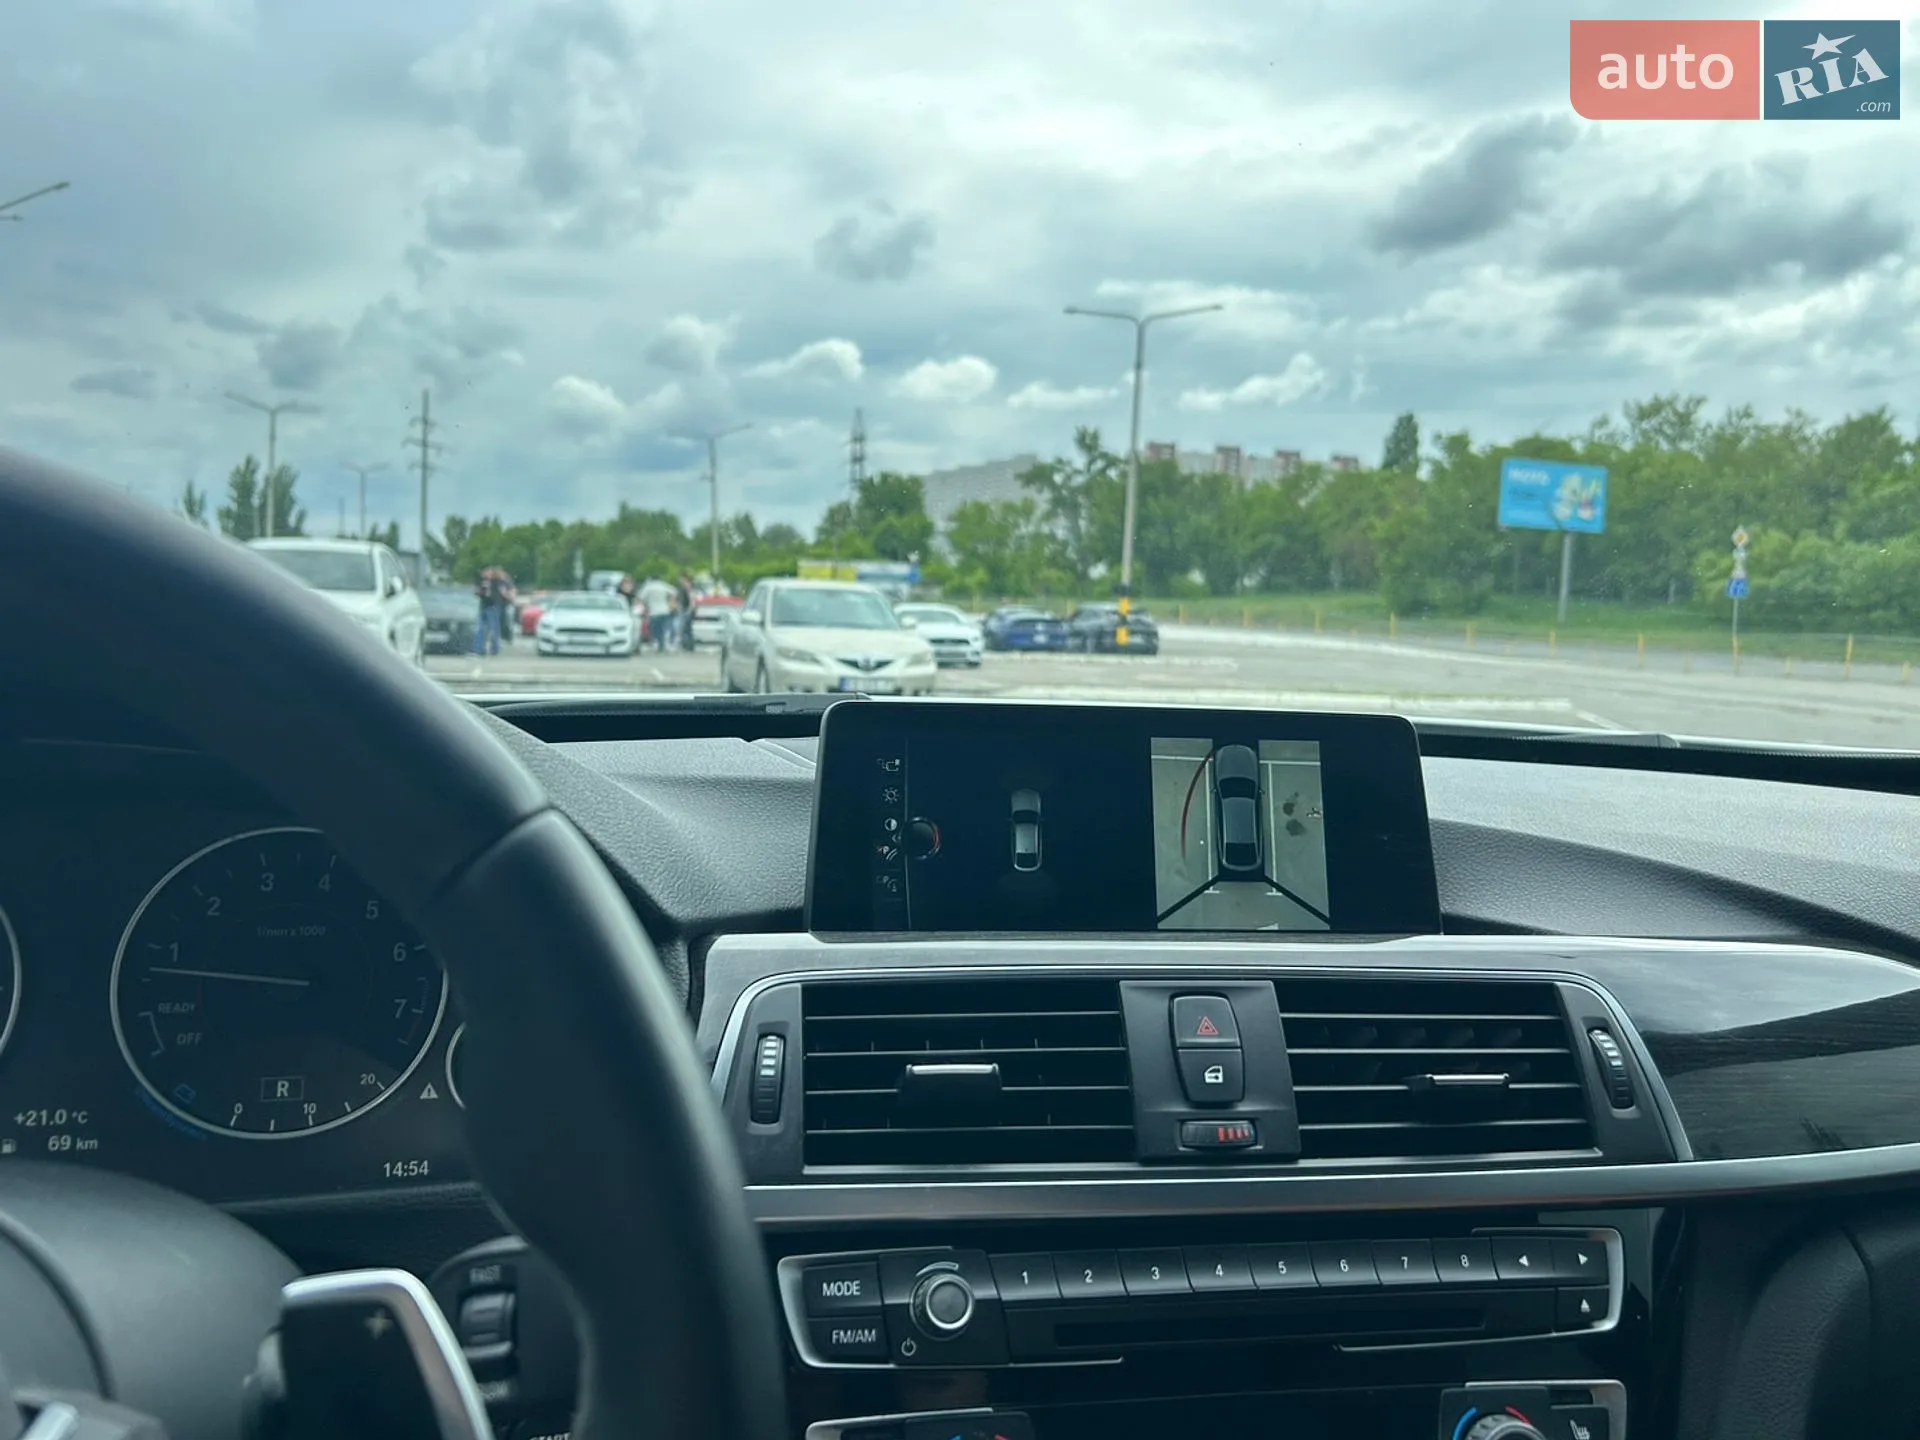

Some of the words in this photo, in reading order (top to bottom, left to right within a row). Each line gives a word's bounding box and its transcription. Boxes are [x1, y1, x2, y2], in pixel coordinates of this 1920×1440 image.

[260, 872, 275, 892] 3
[318, 873, 331, 891] 4
[206, 896, 221, 916] 2
[365, 900, 379, 920] 5
[169, 942, 180, 962] 1
[393, 942, 406, 962] 6
[158, 1002, 196, 1014] READY
[394, 999, 407, 1019] 7
[176, 1033, 202, 1046] OFF
[360, 1074, 376, 1086] 20
[276, 1082, 289, 1097] R
[234, 1103, 243, 1115] 0
[302, 1103, 317, 1115] 10
[14, 1110, 67, 1126] +21.0
[48, 1136, 71, 1152] 69
[76, 1137, 98, 1151] km
[383, 1161, 430, 1178] 14:54
[1278, 1261, 1287, 1274] 5
[1339, 1259, 1349, 1272] 6
[1401, 1256, 1409, 1269] 7
[1460, 1254, 1470, 1268] 8
[1022, 1271, 1029, 1284] 1
[1084, 1269, 1093, 1283] 2
[1151, 1266, 1160, 1280] 3
[1215, 1264, 1224, 1277] 4
[822, 1279, 861, 1297] MODE
[832, 1328, 877, 1344] FM/AM
